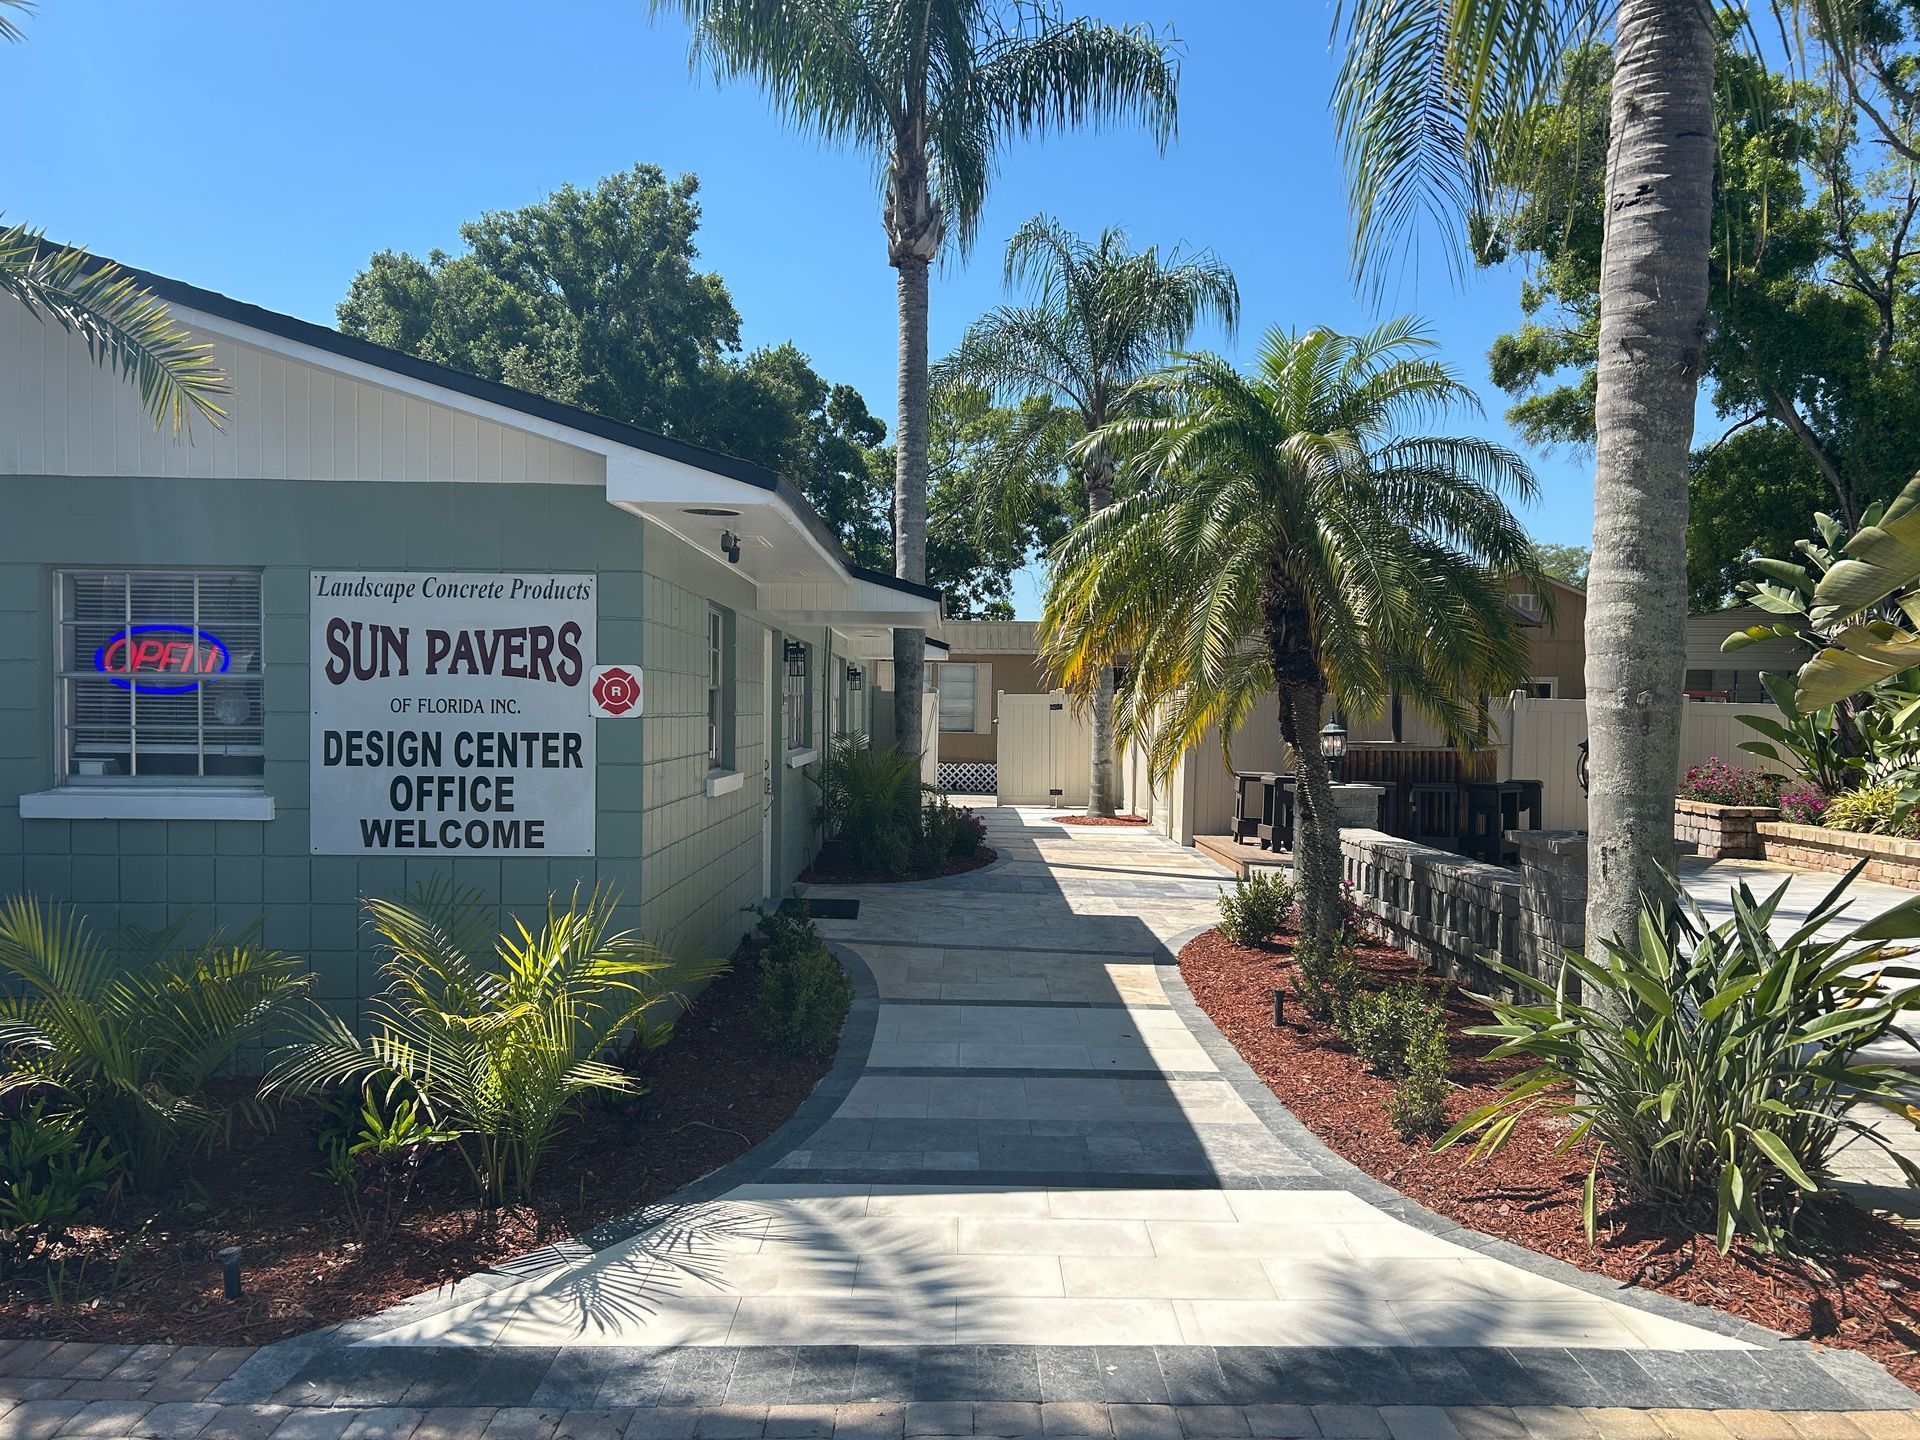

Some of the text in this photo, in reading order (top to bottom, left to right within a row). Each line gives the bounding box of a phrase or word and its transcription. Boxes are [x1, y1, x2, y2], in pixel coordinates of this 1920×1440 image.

[316, 575, 592, 604] Landscape Concrete Products
[104, 638, 219, 673] OPEN
[325, 617, 583, 687] SUN PAVERS
[390, 698, 521, 715] OF FLORIDA INC.
[611, 685, 622, 697] R
[323, 730, 584, 769] DESIGN CENTER
[389, 775, 515, 813] OFFICE
[359, 819, 545, 849] WELCOME
